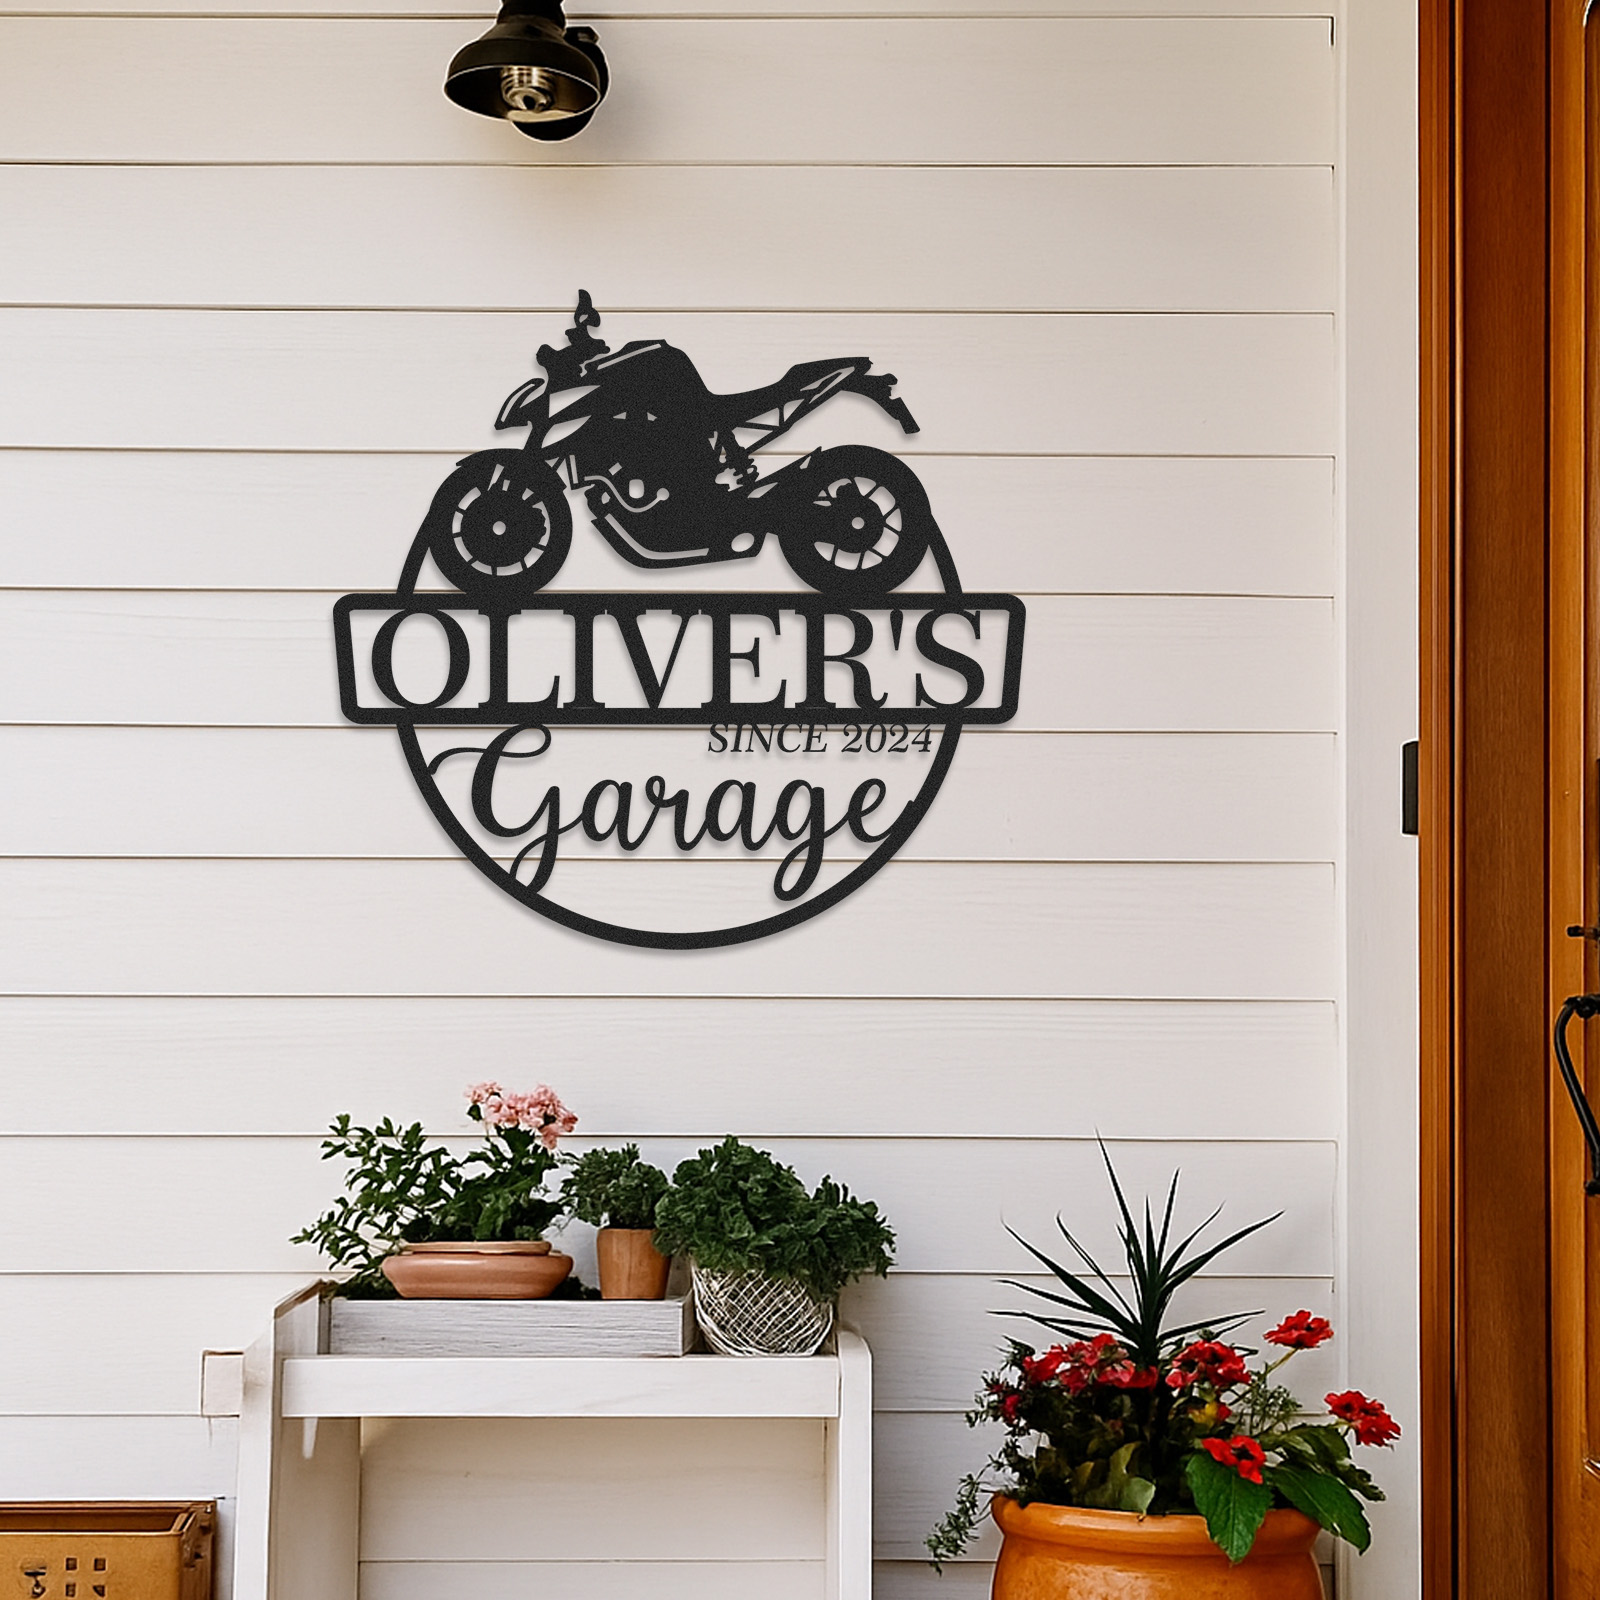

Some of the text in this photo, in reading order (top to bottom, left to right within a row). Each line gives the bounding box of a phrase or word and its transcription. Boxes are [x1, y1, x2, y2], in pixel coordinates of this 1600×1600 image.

[371, 606, 985, 711] OLIVER'S
[707, 722, 932, 753] SINCE 2024
[429, 724, 908, 902] Garage
